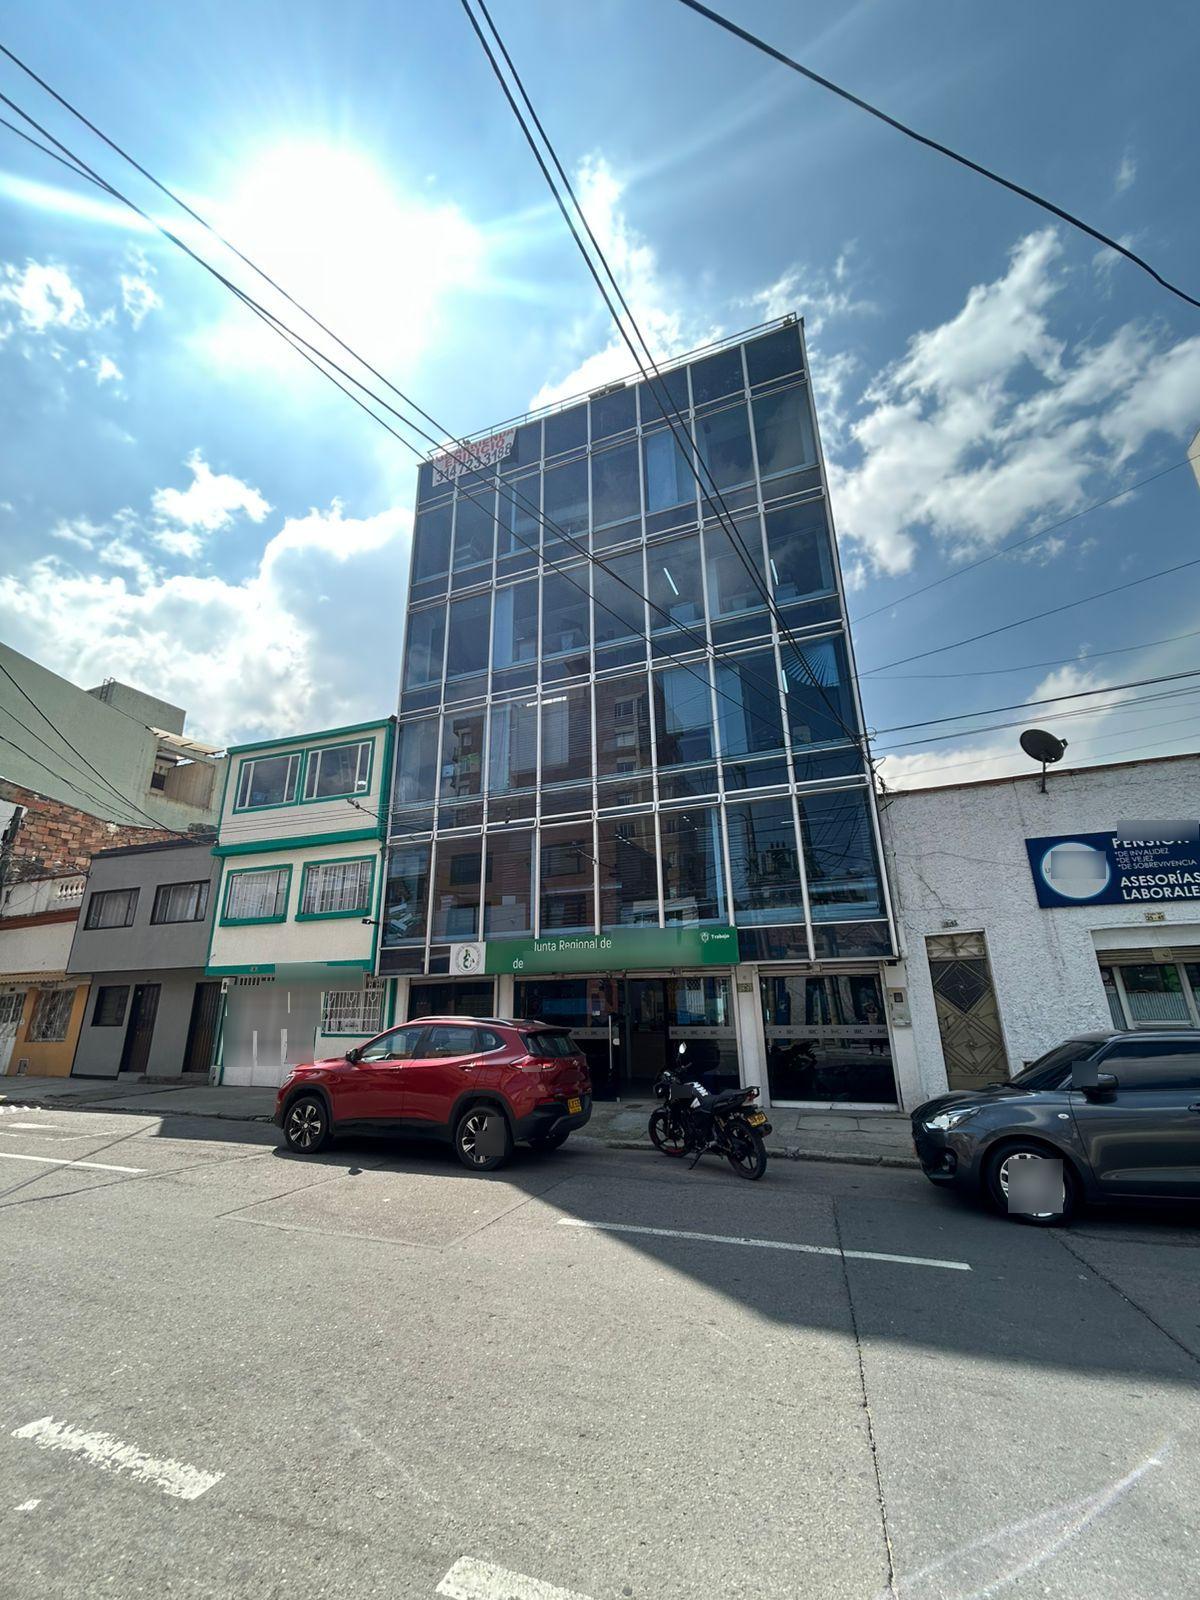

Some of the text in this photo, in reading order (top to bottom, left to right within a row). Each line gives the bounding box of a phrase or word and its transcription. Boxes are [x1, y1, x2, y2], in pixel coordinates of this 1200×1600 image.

[1130, 848, 1170, 856] INVALIDEZ
[1132, 855, 1154, 863] VEJEZ
[1134, 859, 1197, 870] SOBREVIVENCIA
[1121, 870, 1200, 887] ASESORÍAS
[1122, 886, 1200, 900] LABORALE
[600, 937, 612, 949] de
[512, 958, 524, 969] de
